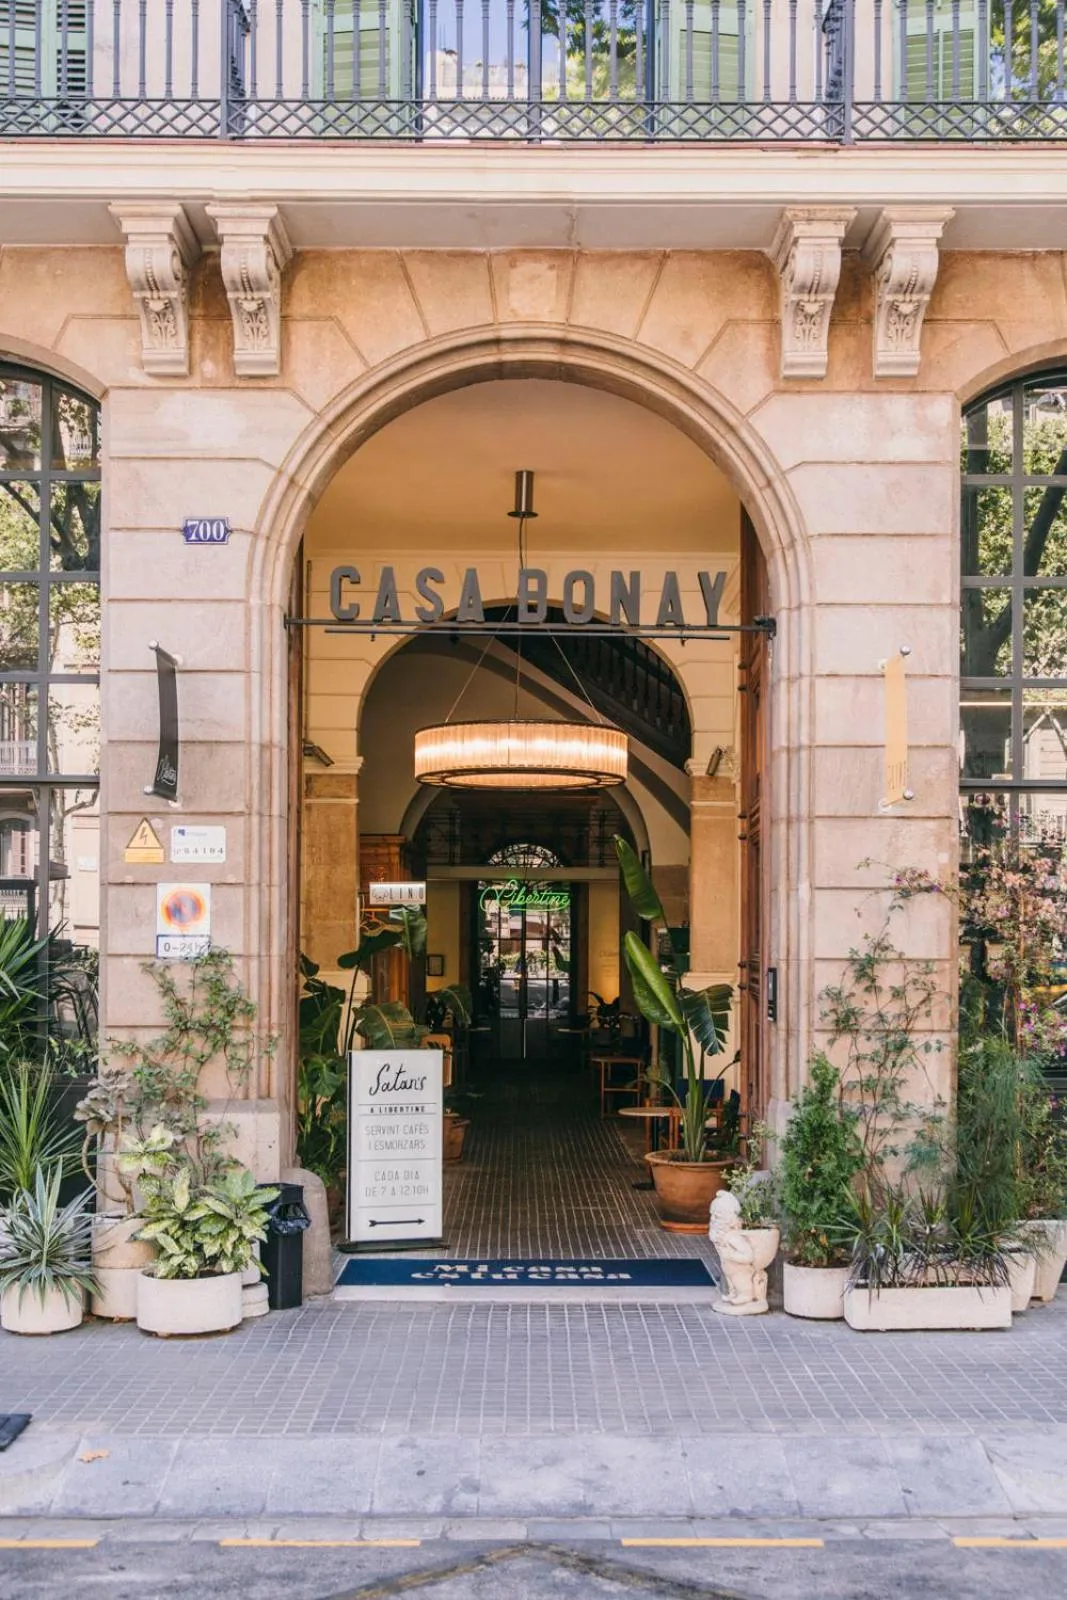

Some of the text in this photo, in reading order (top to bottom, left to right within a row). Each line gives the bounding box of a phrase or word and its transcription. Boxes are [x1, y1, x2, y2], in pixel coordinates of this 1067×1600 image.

[187, 520, 225, 541] 700
[331, 565, 728, 626] CASA BONAY
[369, 1063, 428, 1096] Satan's
[374, 1169, 400, 1181] CADA
